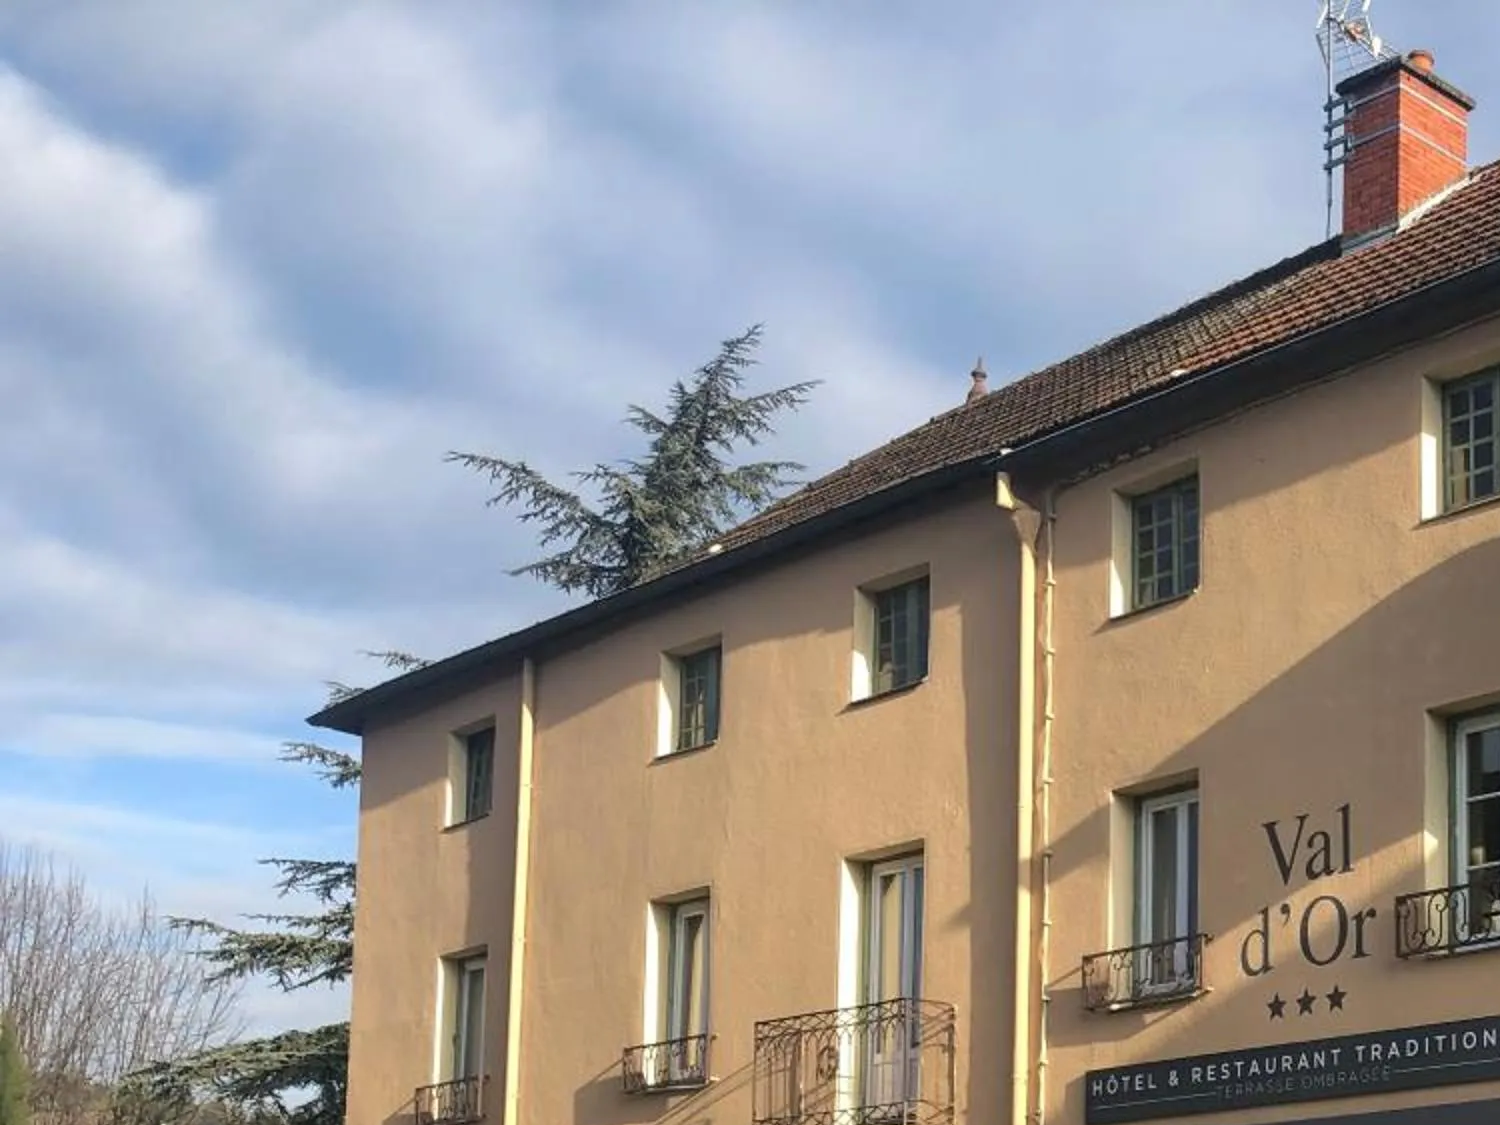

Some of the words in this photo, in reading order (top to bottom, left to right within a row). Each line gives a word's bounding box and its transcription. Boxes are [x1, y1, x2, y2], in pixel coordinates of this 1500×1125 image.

[1261, 803, 1353, 886] Val
[1241, 896, 1376, 976] d'Or
[1091, 1073, 1157, 1098] HÔTEL
[1168, 1069, 1179, 1087] &
[1191, 1048, 1341, 1083] RESTAURANT
